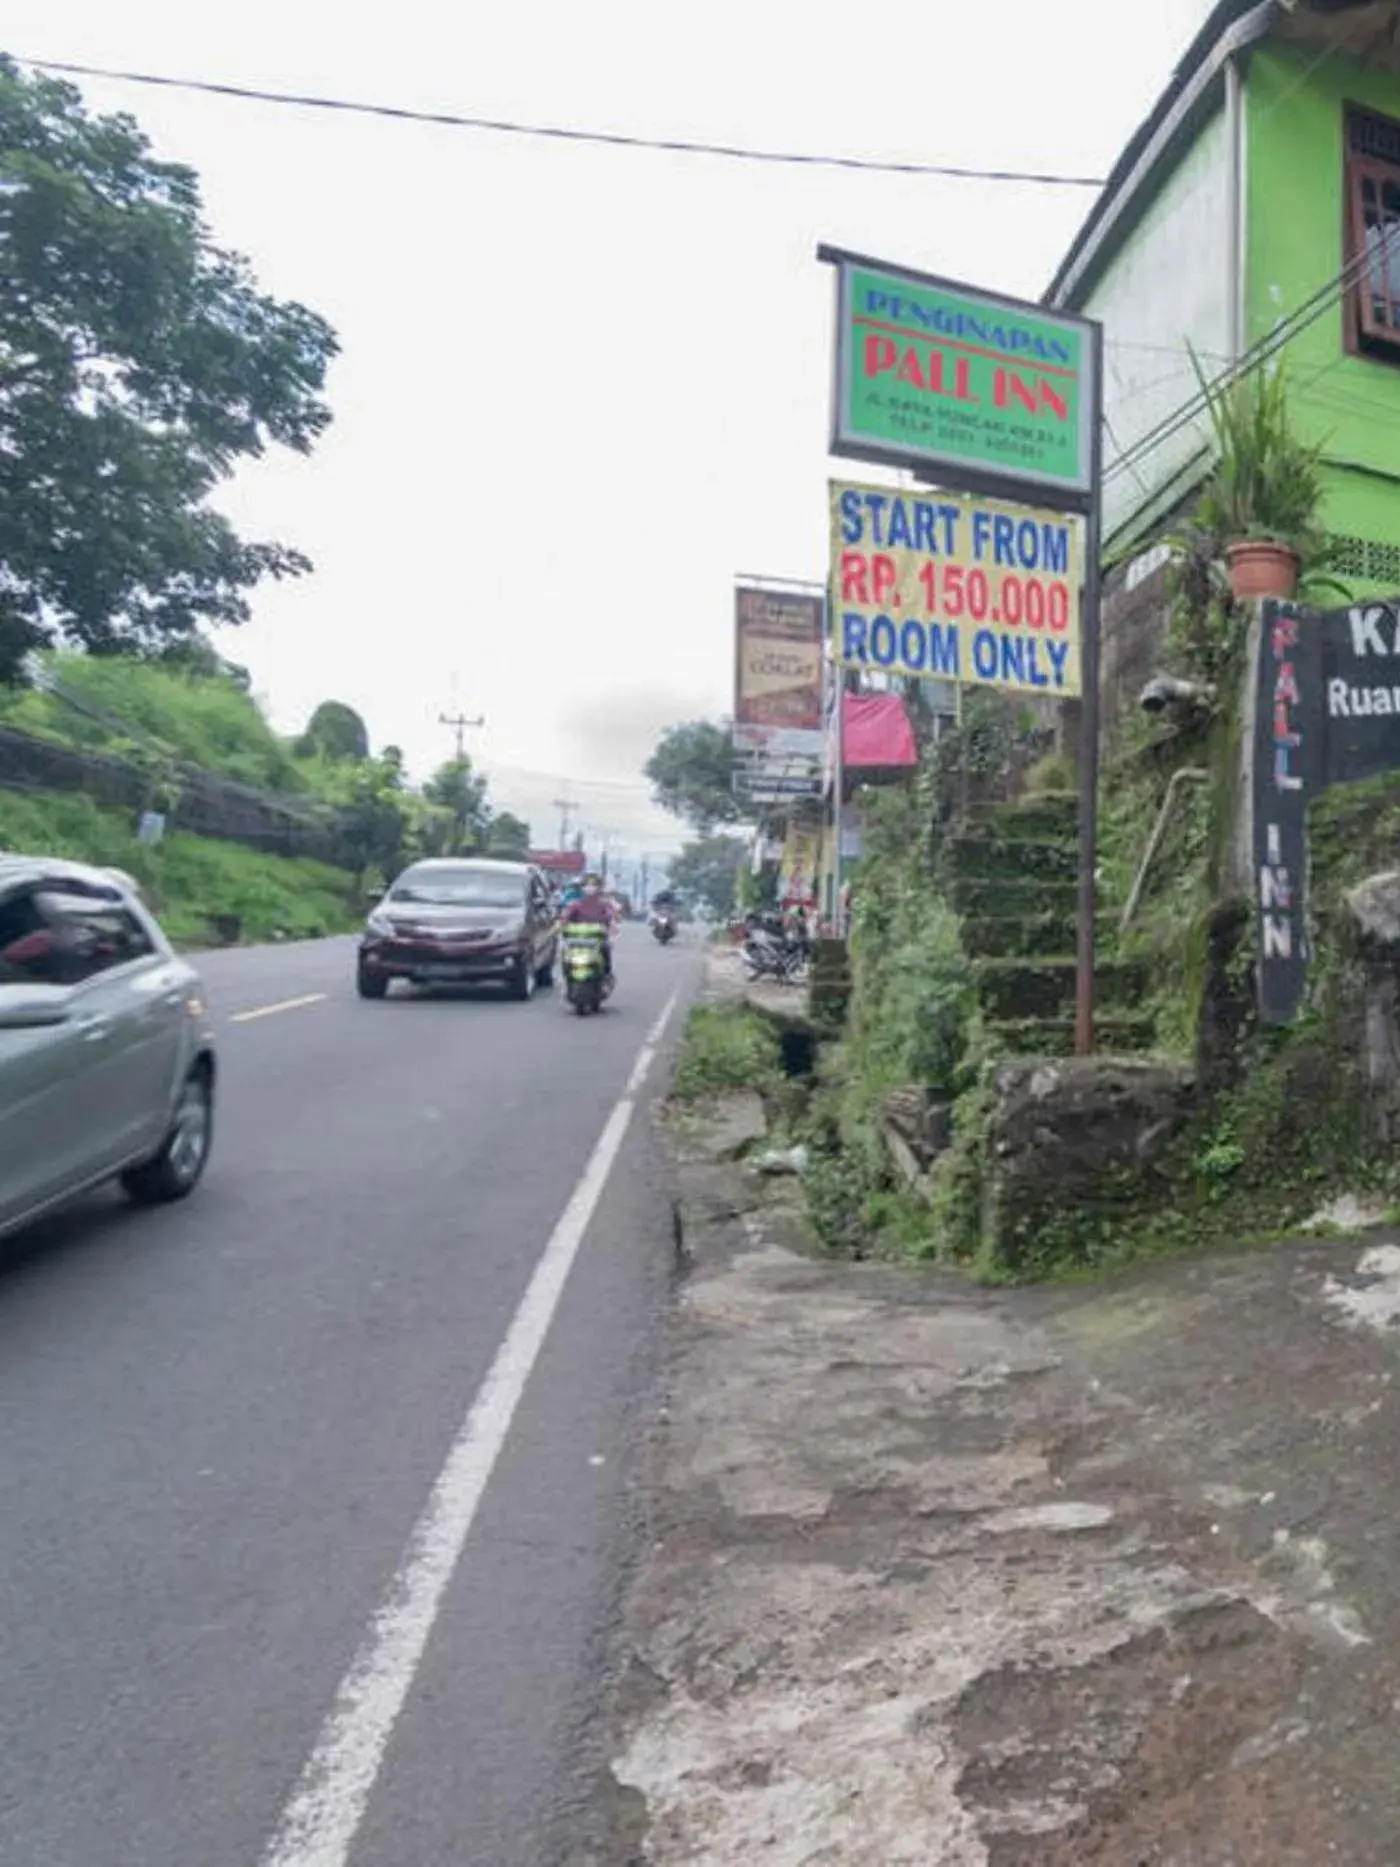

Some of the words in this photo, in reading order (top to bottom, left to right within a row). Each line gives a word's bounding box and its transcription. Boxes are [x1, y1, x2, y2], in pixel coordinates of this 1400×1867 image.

[866, 290, 1070, 363] PENGINAPAN
[863, 335, 980, 403] PALL
[994, 367, 1068, 422] INN
[840, 490, 960, 556] START
[972, 511, 1069, 574] FROM
[841, 552, 902, 607] RP.
[919, 560, 1069, 631] 150.000
[843, 614, 959, 675] ROOM
[973, 629, 1068, 687] ONLY
